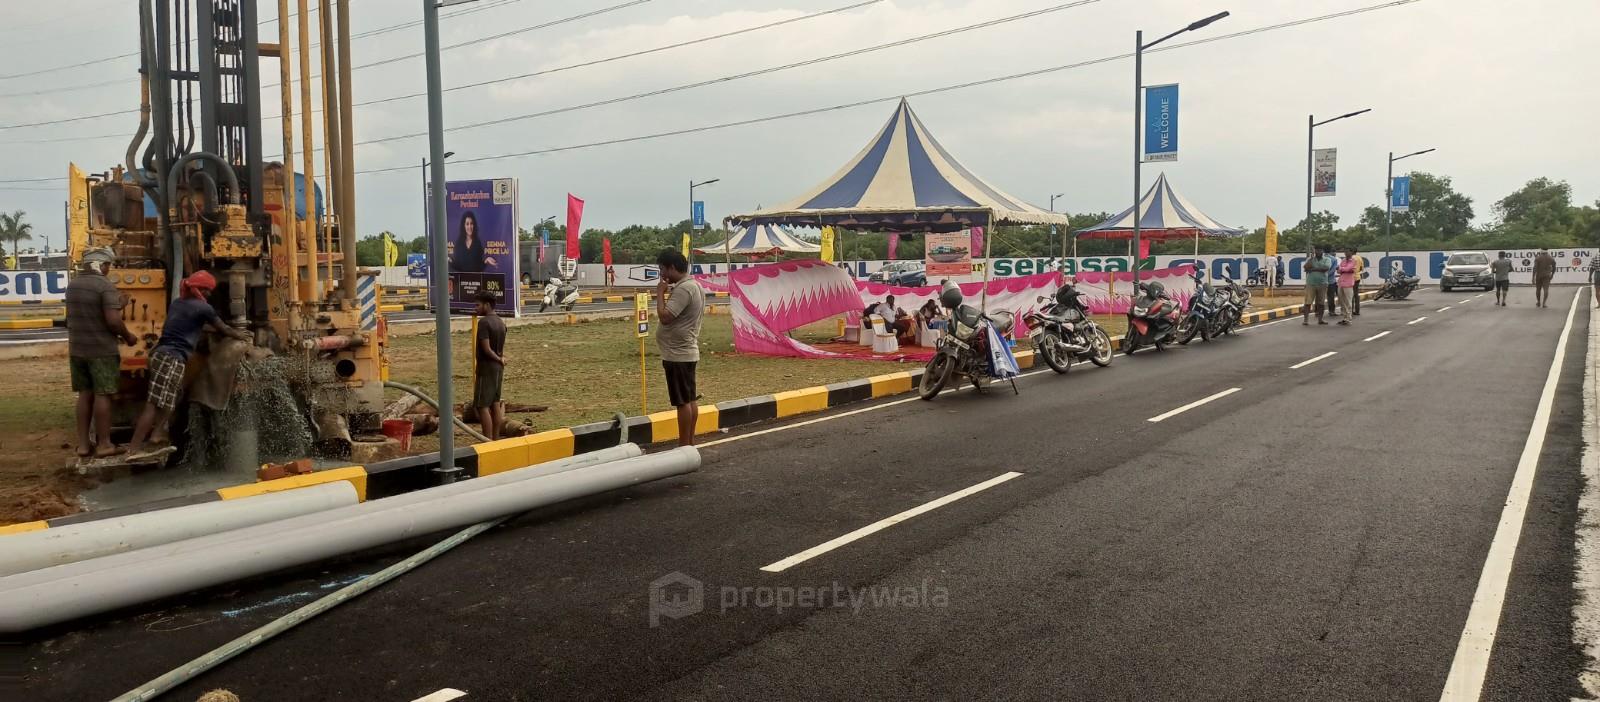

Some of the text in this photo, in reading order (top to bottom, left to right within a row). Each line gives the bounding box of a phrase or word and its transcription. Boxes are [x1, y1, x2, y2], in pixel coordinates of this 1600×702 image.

[1160, 97, 1169, 149] WELCOME
[993, 256, 1128, 277] serasa
[487, 281, 499, 290] 80%
